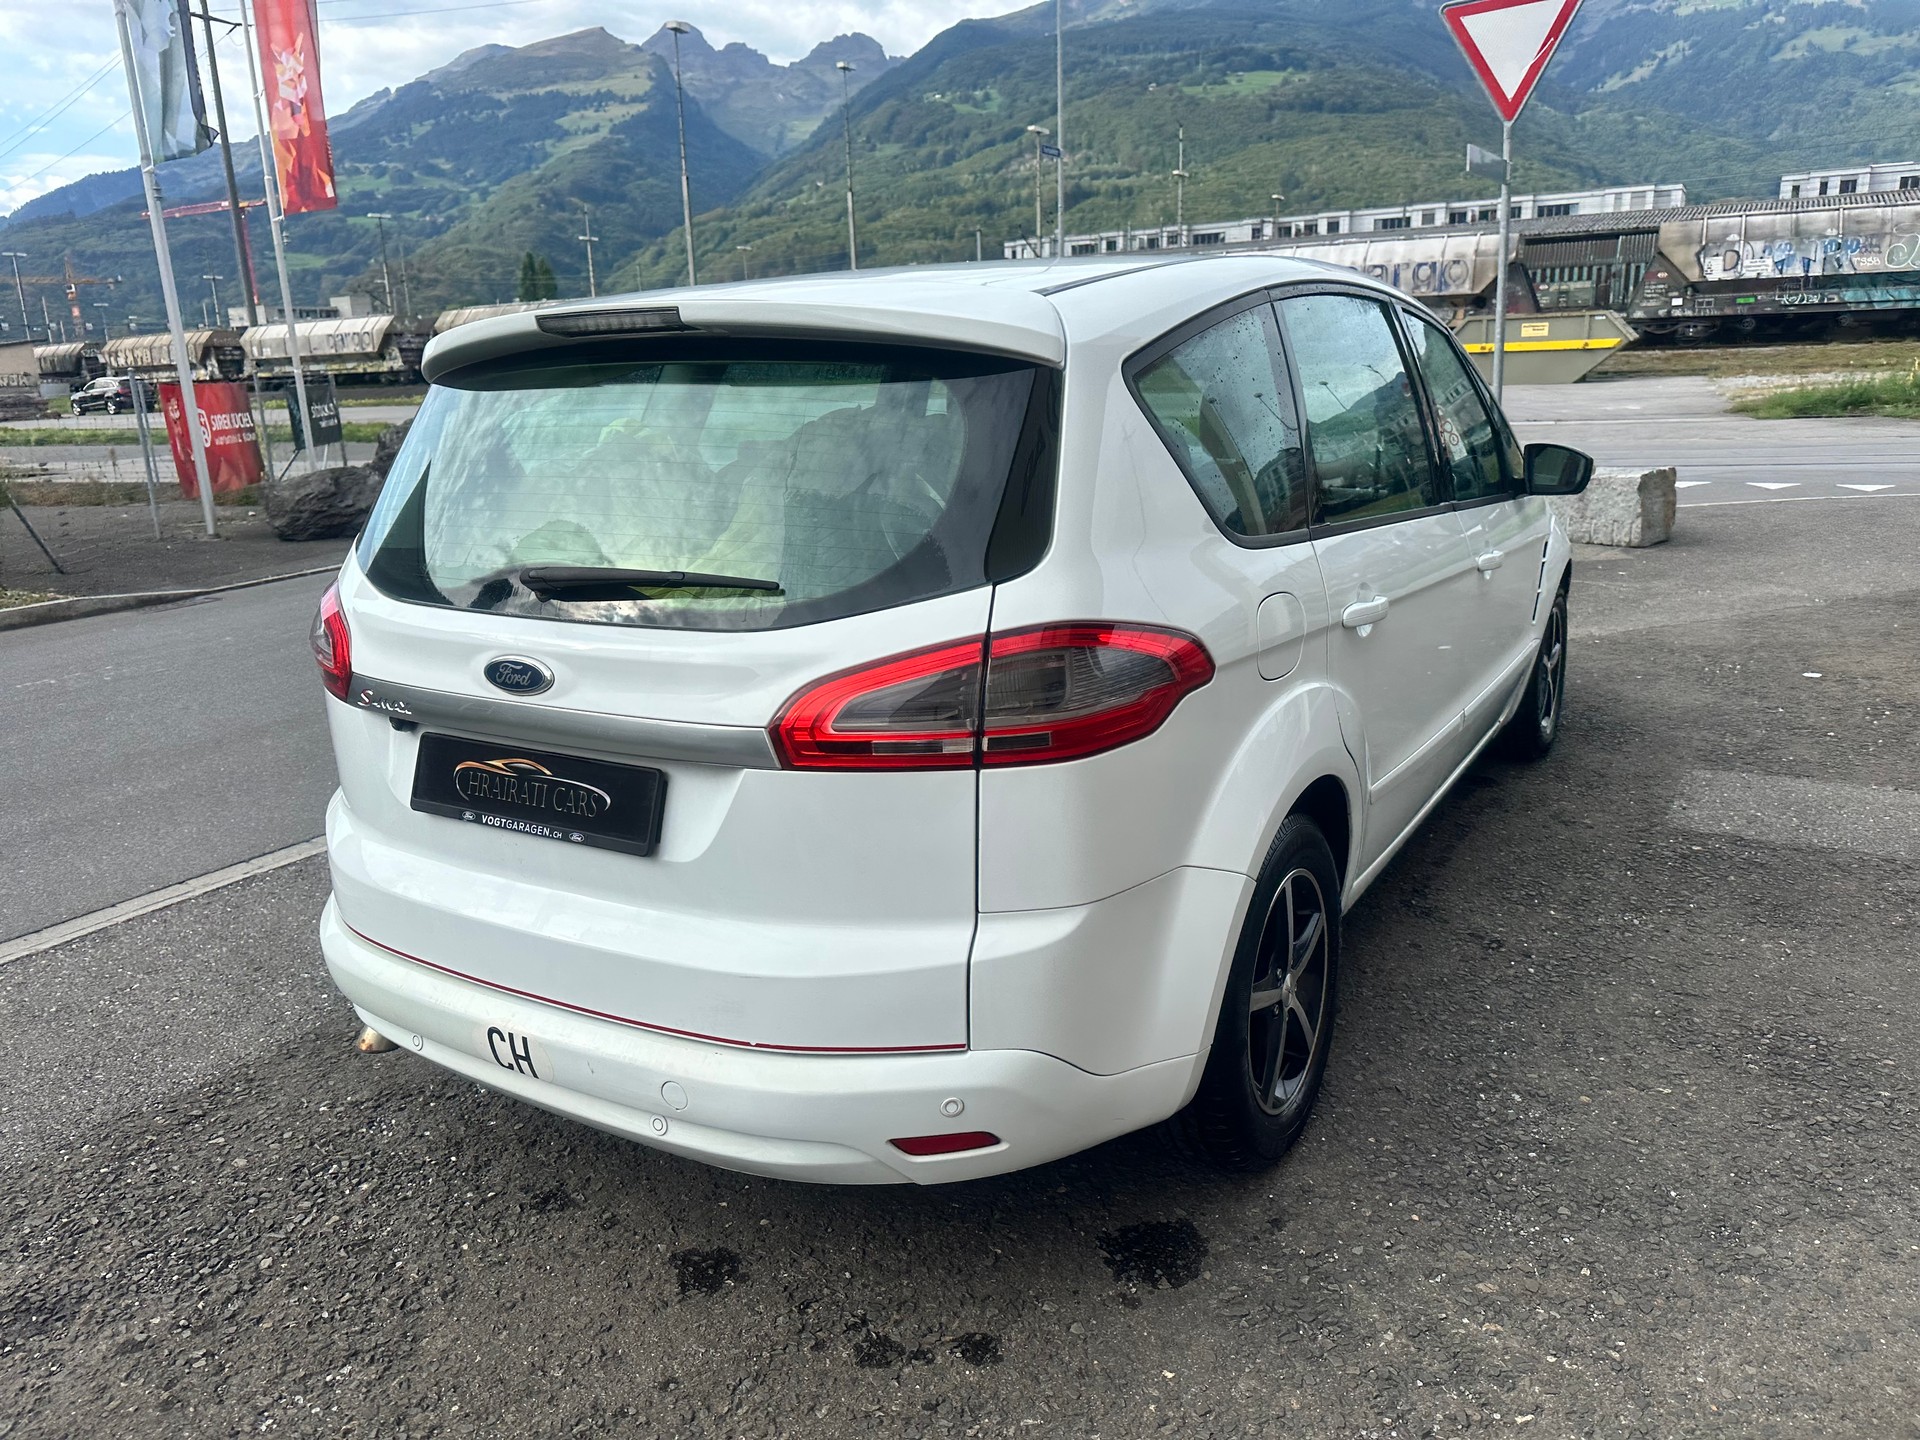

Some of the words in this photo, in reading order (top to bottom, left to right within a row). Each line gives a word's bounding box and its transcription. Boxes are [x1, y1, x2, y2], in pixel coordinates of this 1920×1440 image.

[1341, 259, 1470, 294] argo
[496, 662, 531, 686] Ford
[553, 786, 599, 818] CARS
[487, 1026, 540, 1080] CH
